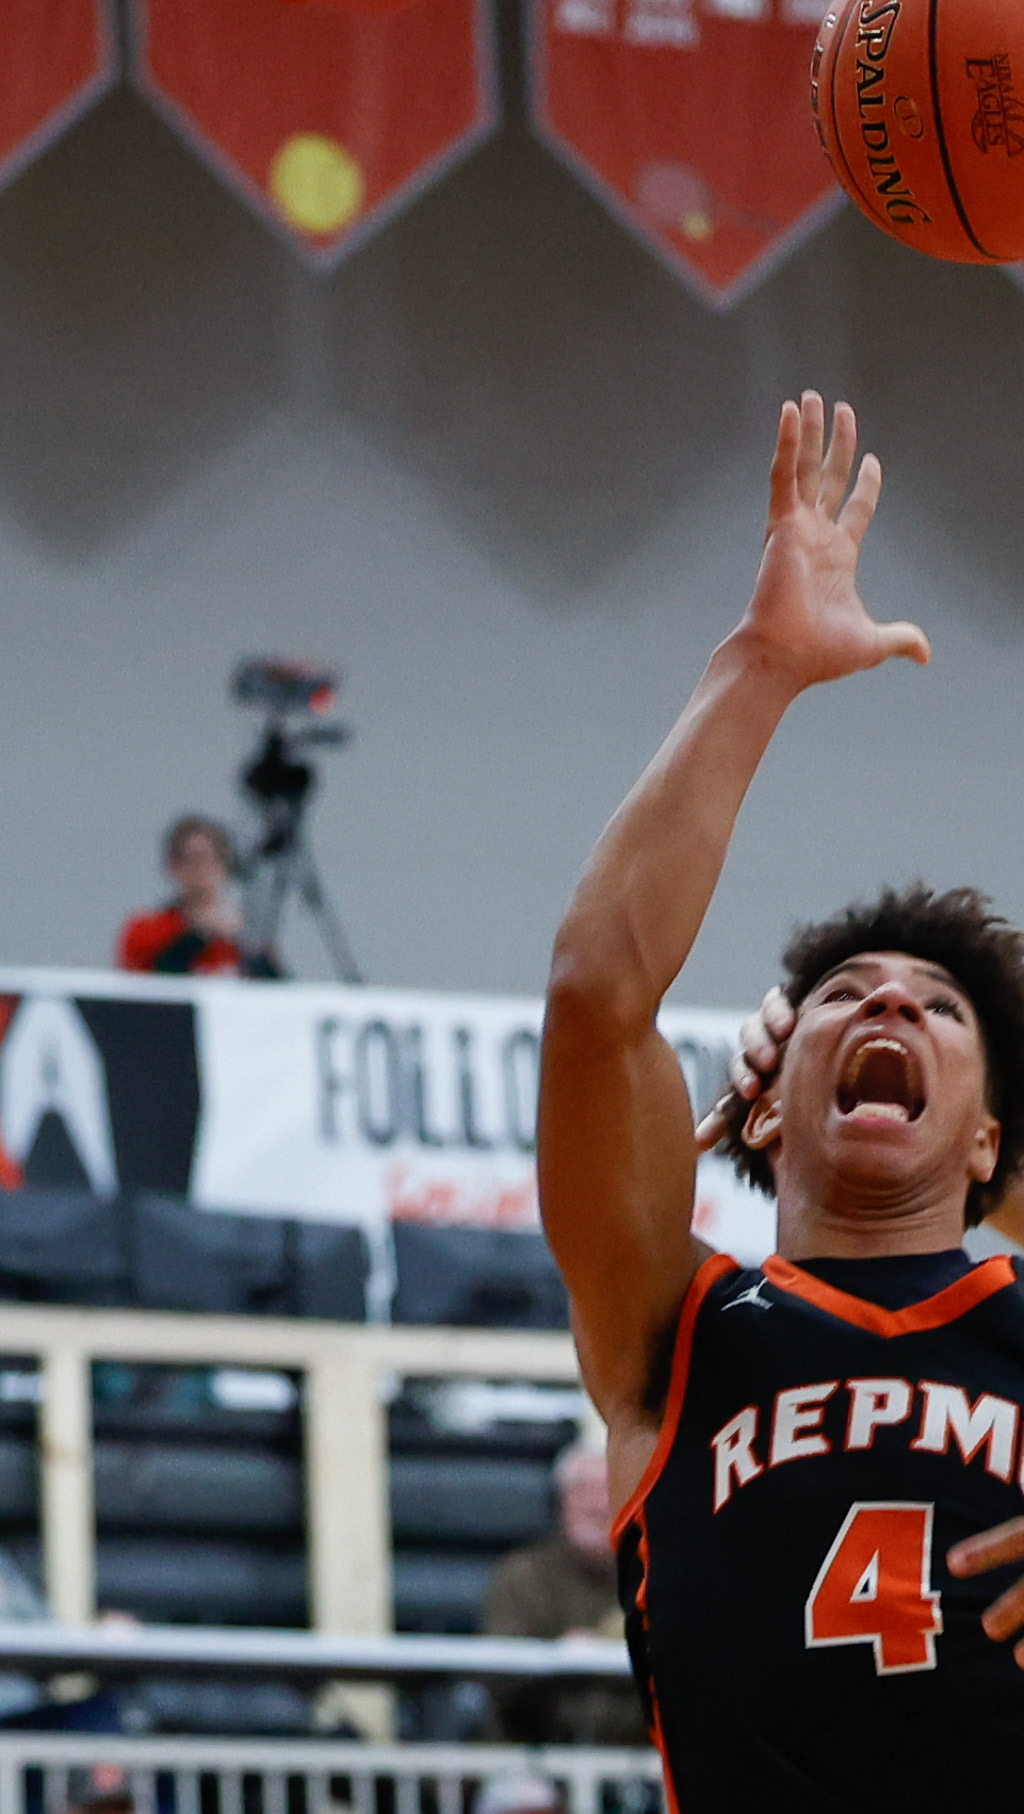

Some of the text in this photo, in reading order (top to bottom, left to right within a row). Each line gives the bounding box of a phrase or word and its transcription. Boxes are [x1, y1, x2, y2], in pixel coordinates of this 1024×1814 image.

[855, 0, 932, 225] SPALDING
[965, 54, 1006, 147] EAGLES
[317, 1014, 541, 1153] FOLLO
[805, 1501, 943, 1677] 4
